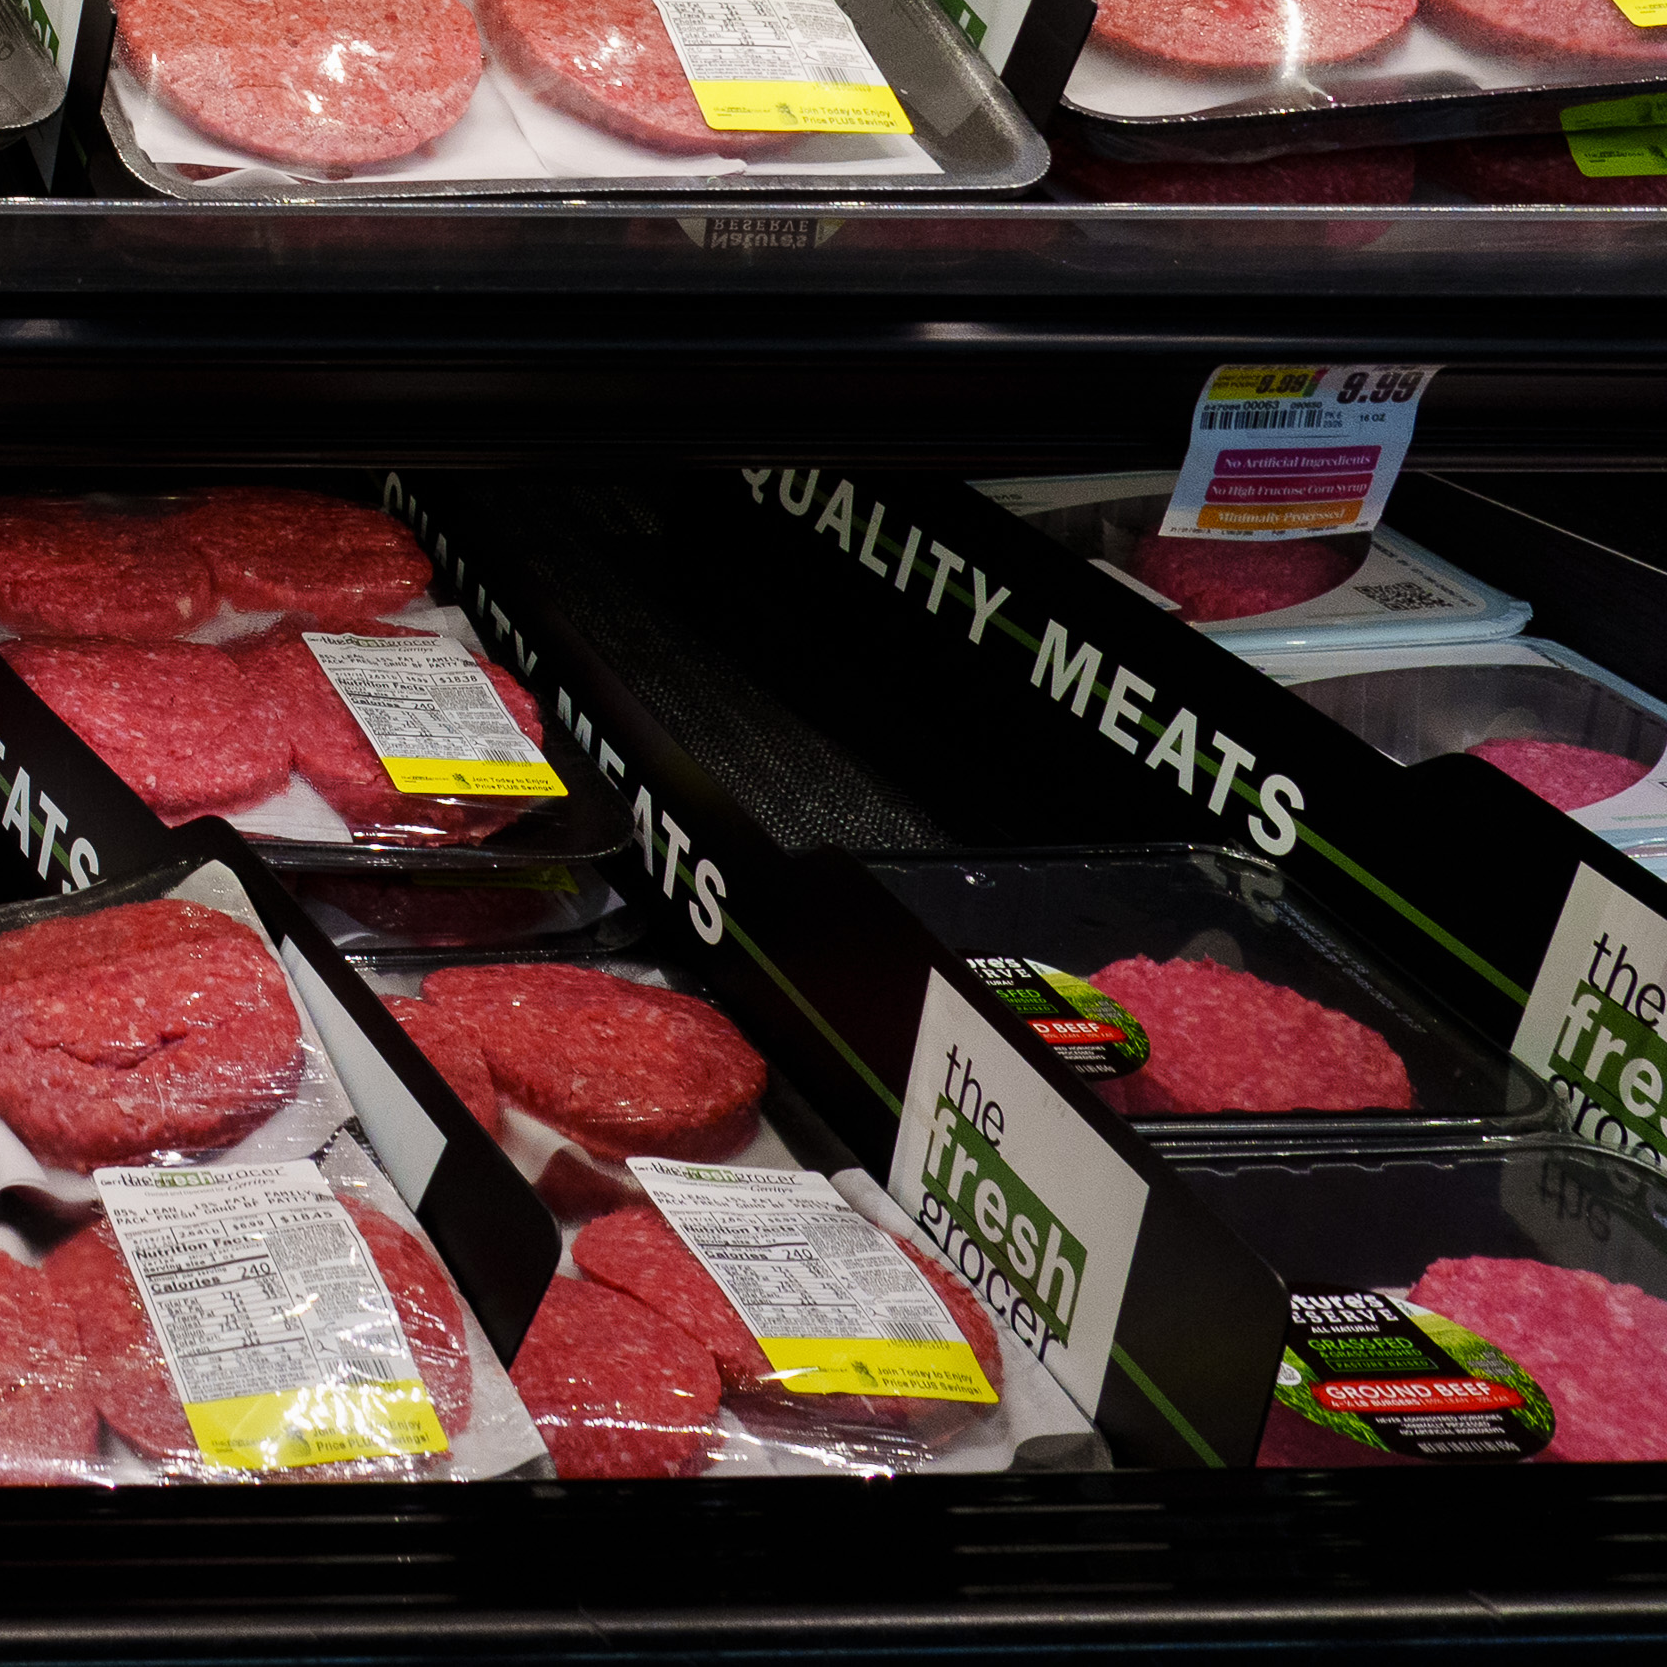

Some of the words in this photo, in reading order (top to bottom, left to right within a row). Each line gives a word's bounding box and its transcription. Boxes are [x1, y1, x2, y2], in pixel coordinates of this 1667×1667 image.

[1256, 373, 1309, 395] 9.99
[1337, 372, 1425, 405] 9.99
[1244, 401, 1280, 410] 00063
[1372, 414, 1386, 422] OZ
[1225, 458, 1241, 469] No
[1244, 455, 1298, 469] Artificial
[1301, 453, 1370, 469] Ingredients
[1213, 486, 1225, 497] No
[1228, 486, 1256, 499] High
[1257, 486, 1306, 497] Fructose
[1307, 484, 1333, 496] Corn
[1335, 482, 1367, 497] Syrup
[1219, 511, 1279, 525] Minimally
[1284, 510, 1346, 523] Processed
[1030, 618, 1305, 858] MEATS
[1588, 931, 1667, 1028] the
[1052, 1023, 1100, 1033] BEEF
[1557, 992, 1667, 1139] fre
[945, 1044, 1005, 1157] the
[926, 1106, 1076, 1329] fresh
[151, 1275, 221, 1293] Calories
[239, 1263, 271, 1280] 240
[918, 1191, 1069, 1364] grocer
[1292, 1309, 1399, 1324] ESERVE
[1326, 1383, 1433, 1400] GROUND
[1433, 1381, 1493, 1398] BEEF
